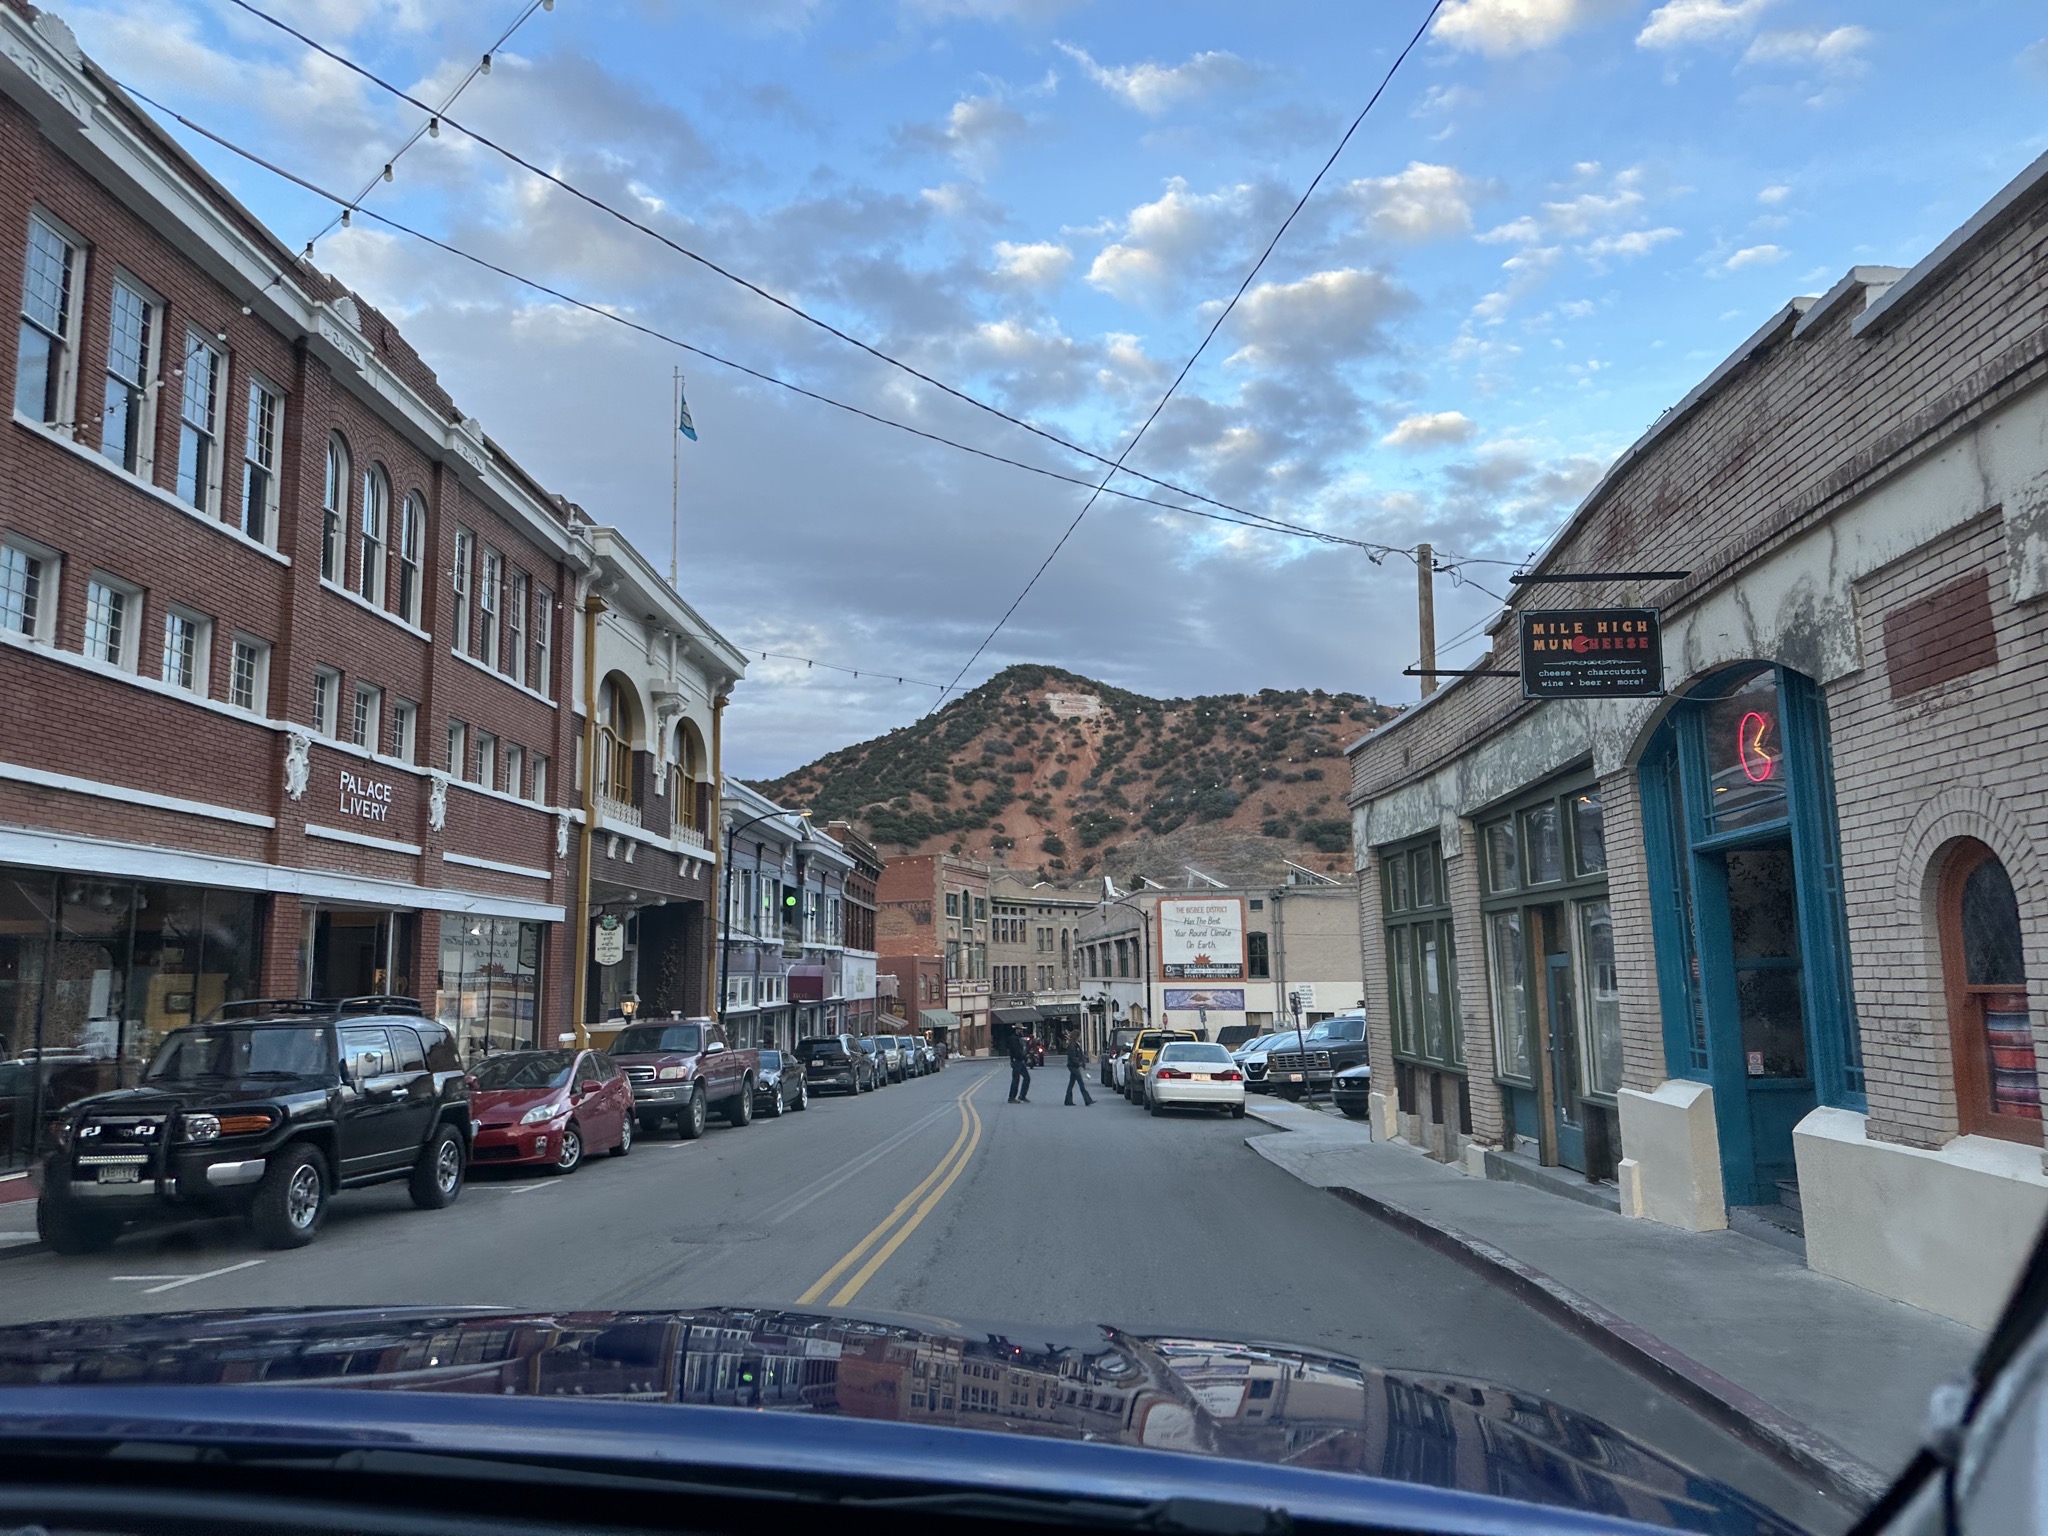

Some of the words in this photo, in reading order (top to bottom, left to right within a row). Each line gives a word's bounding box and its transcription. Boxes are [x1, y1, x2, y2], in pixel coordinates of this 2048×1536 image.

[1533, 622, 1583, 635] MILE
[1597, 620, 1647, 634] HIGH
[1538, 669, 1571, 677] cheese
[1587, 667, 1648, 676] charcuterie
[1617, 678, 1644, 686] more!
[339, 770, 392, 803] PALACE
[339, 792, 388, 822] LIVERY
[1183, 917, 1195, 925] Has
[1196, 917, 1207, 925] The
[1208, 917, 1221, 925] Best
[1174, 929, 1187, 937] Year
[1188, 929, 1208, 937] Round
[1187, 940, 1194, 948] On
[1198, 940, 1216, 948] Earth
[80, 1126, 101, 1138] FJ
[135, 1125, 156, 1136] FJ
